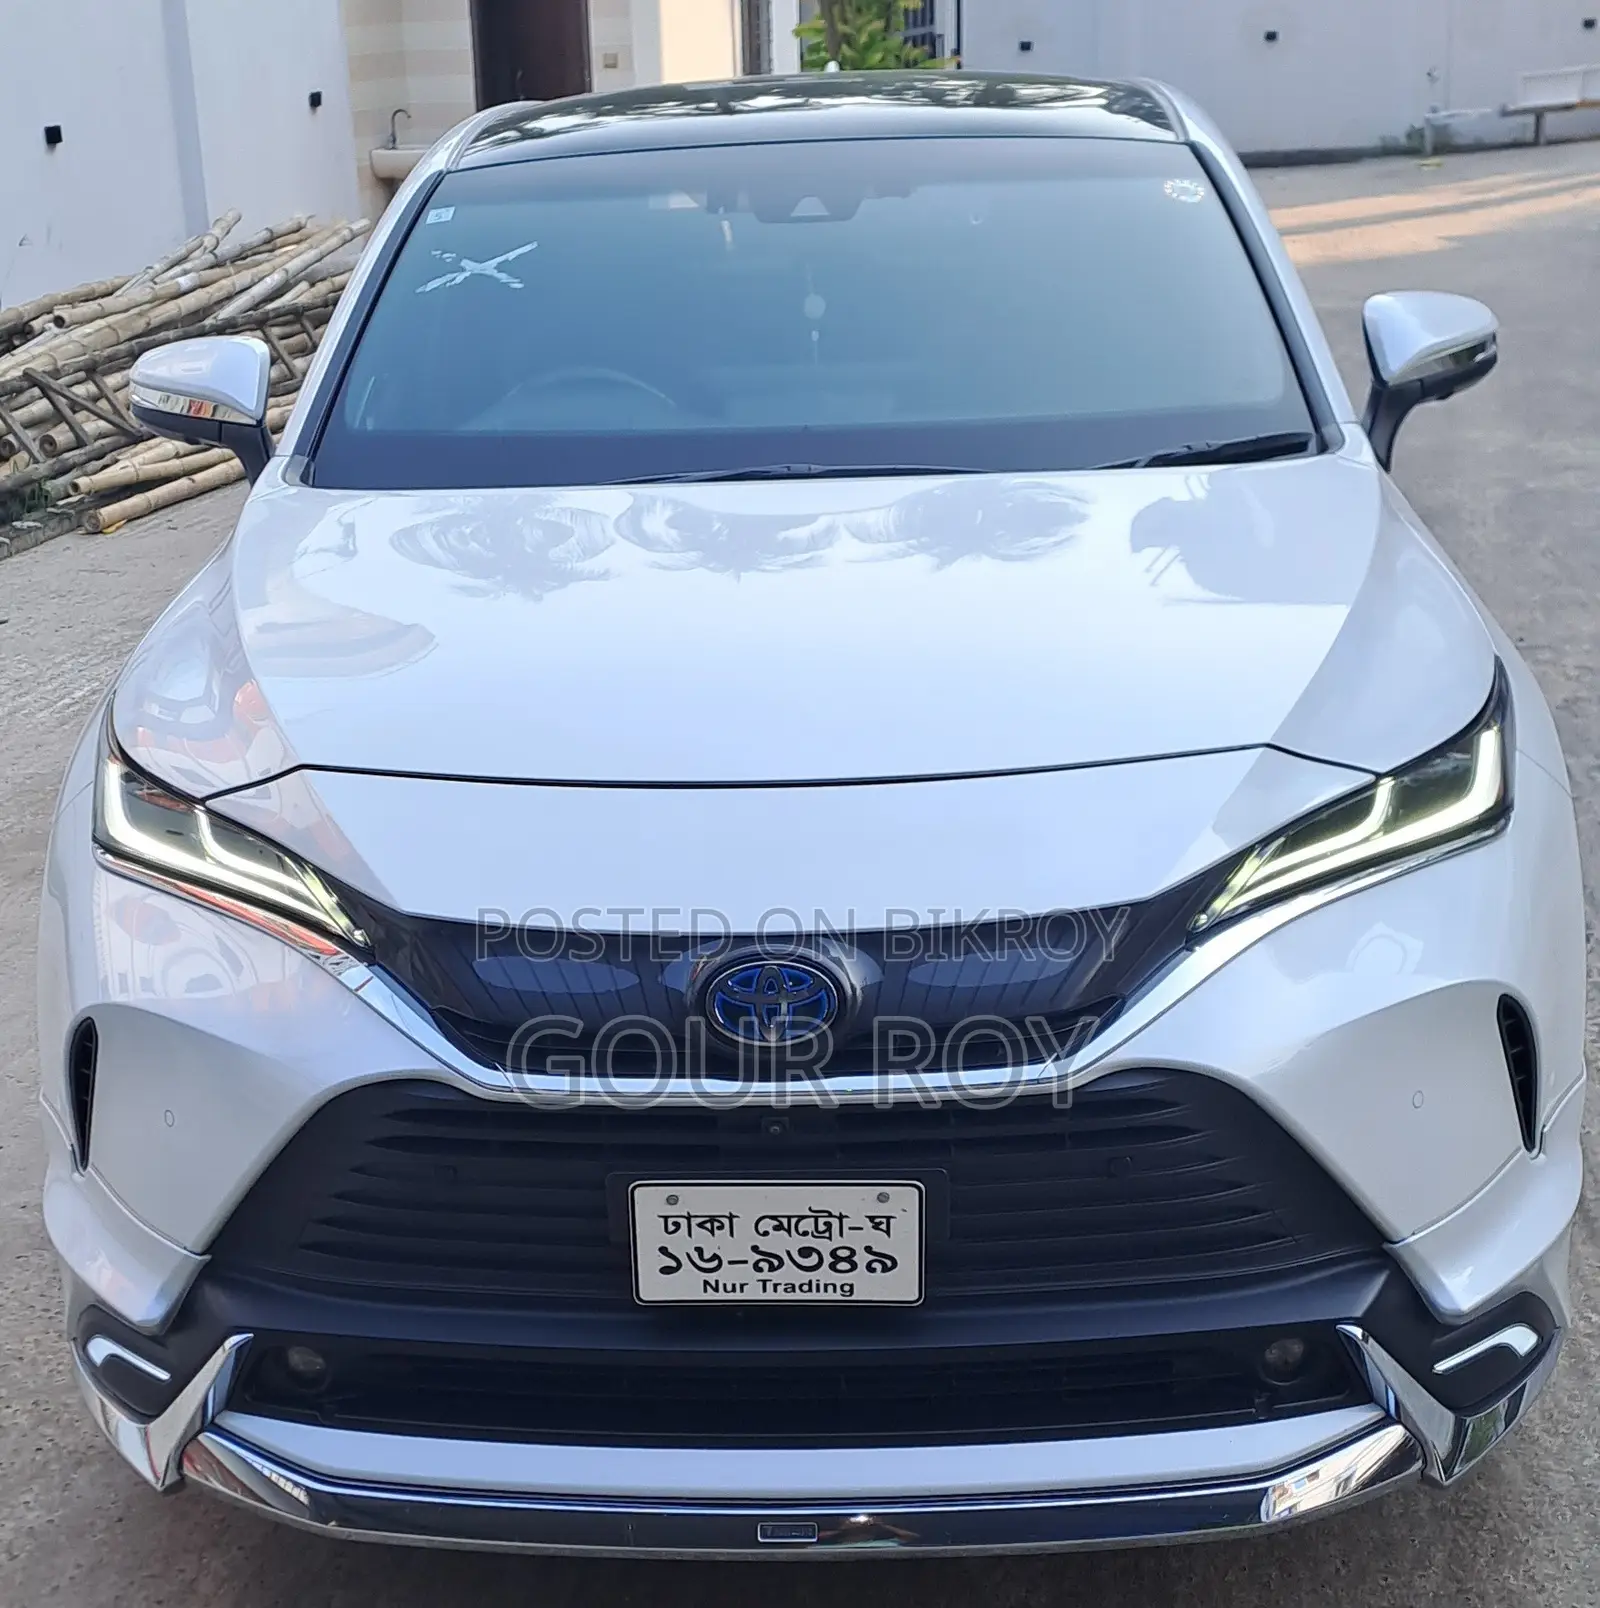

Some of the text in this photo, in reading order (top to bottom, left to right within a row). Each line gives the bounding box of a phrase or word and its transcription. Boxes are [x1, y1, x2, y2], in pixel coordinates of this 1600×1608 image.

[657, 1211, 740, 1239] ঢাকা
[657, 1244, 898, 1275] ১৬-৯৩৪৯
[702, 1279, 855, 1297] Nur Trading
